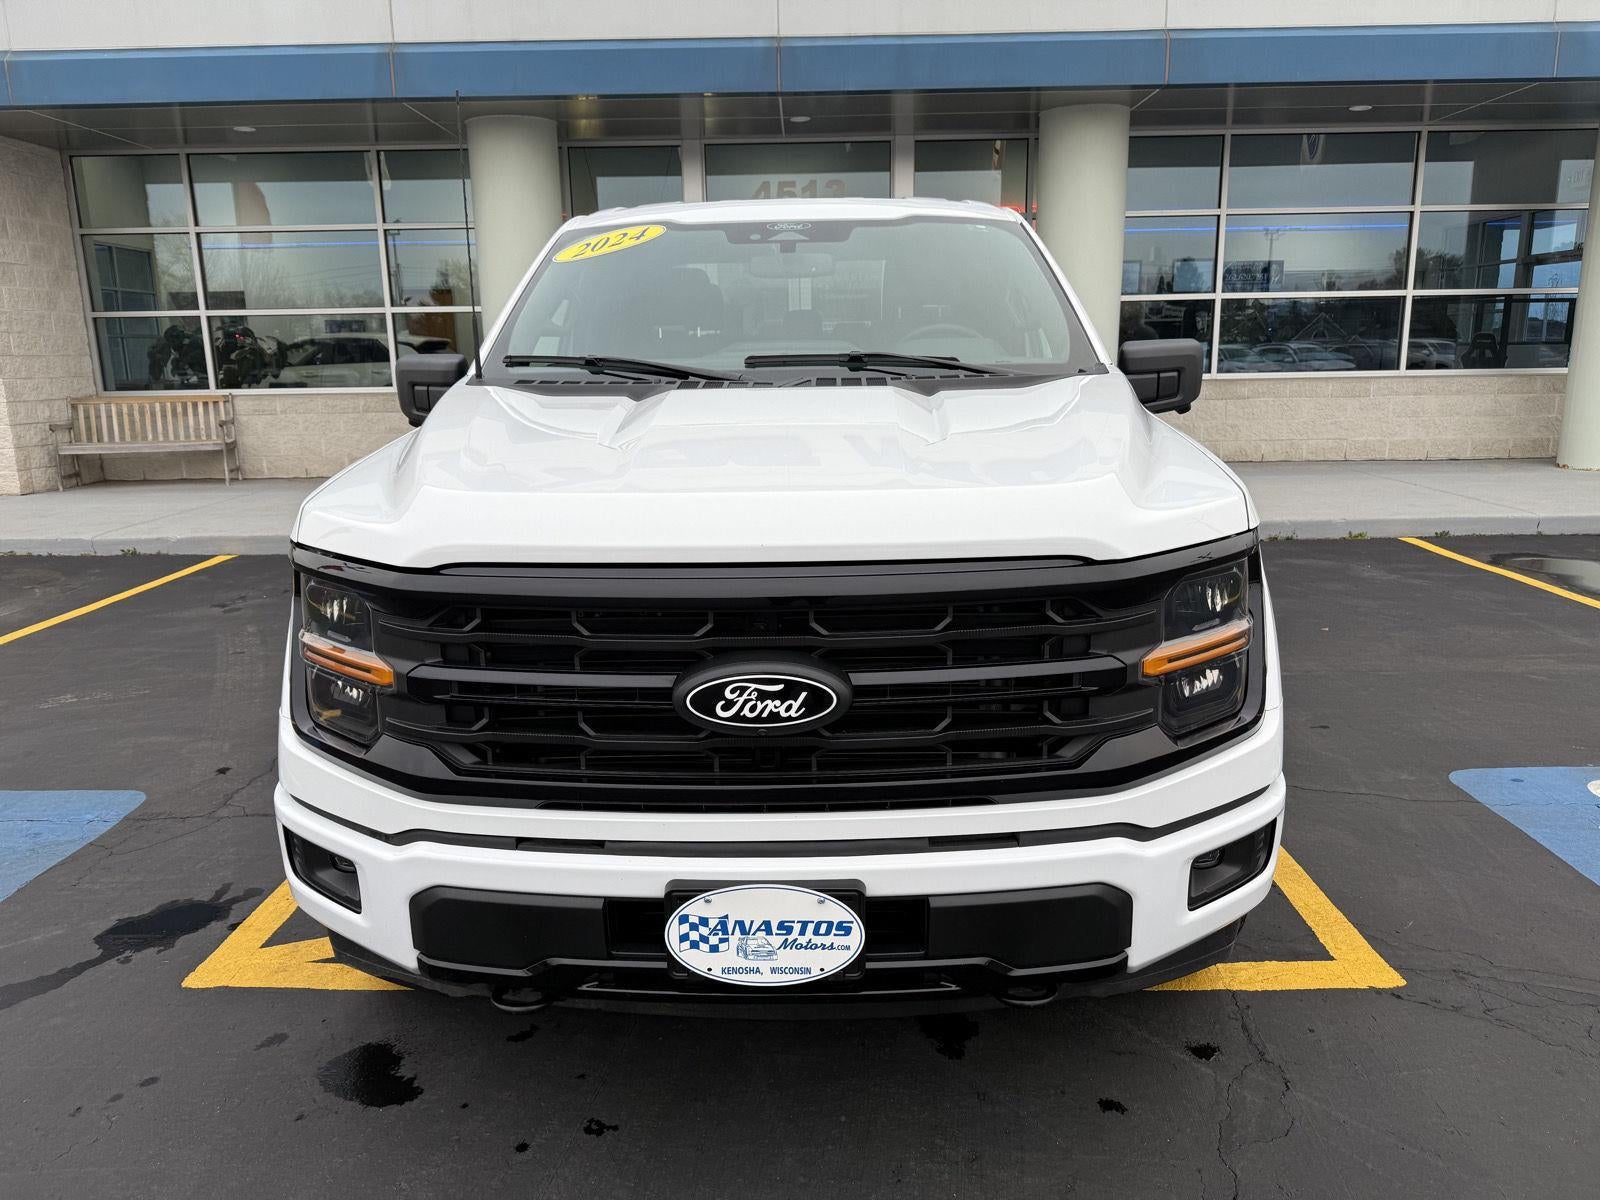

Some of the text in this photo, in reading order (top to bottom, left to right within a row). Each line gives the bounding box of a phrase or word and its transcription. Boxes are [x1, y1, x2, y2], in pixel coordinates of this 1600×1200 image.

[571, 225, 651, 258] 2024
[715, 682, 808, 718] Ford
[707, 919, 854, 937] ANASTOS
[721, 966, 812, 976] KENOSHA, WISCONSIN
